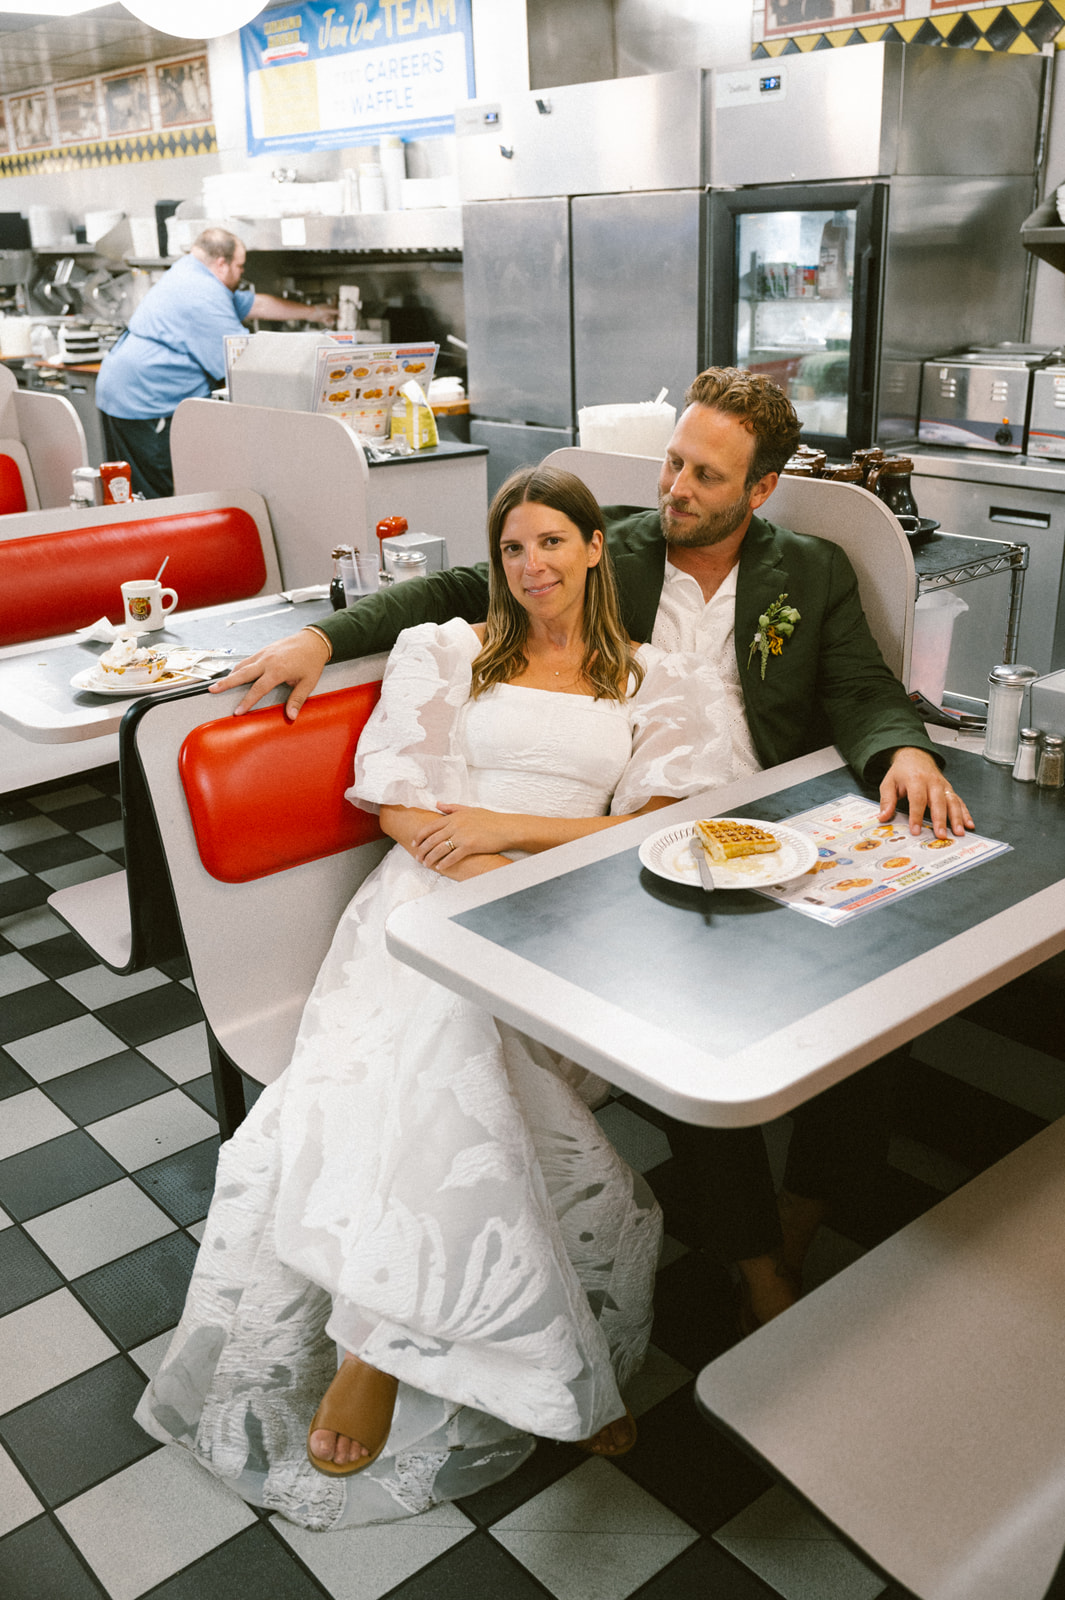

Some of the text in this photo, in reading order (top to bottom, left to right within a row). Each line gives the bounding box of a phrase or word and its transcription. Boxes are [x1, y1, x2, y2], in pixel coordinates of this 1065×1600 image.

[318, 8, 349, 50] Join
[350, 3, 382, 45] Our
[379, 0, 457, 38] TEAM
[365, 50, 444, 83] CAREERS
[352, 87, 414, 114] WAFFLE
